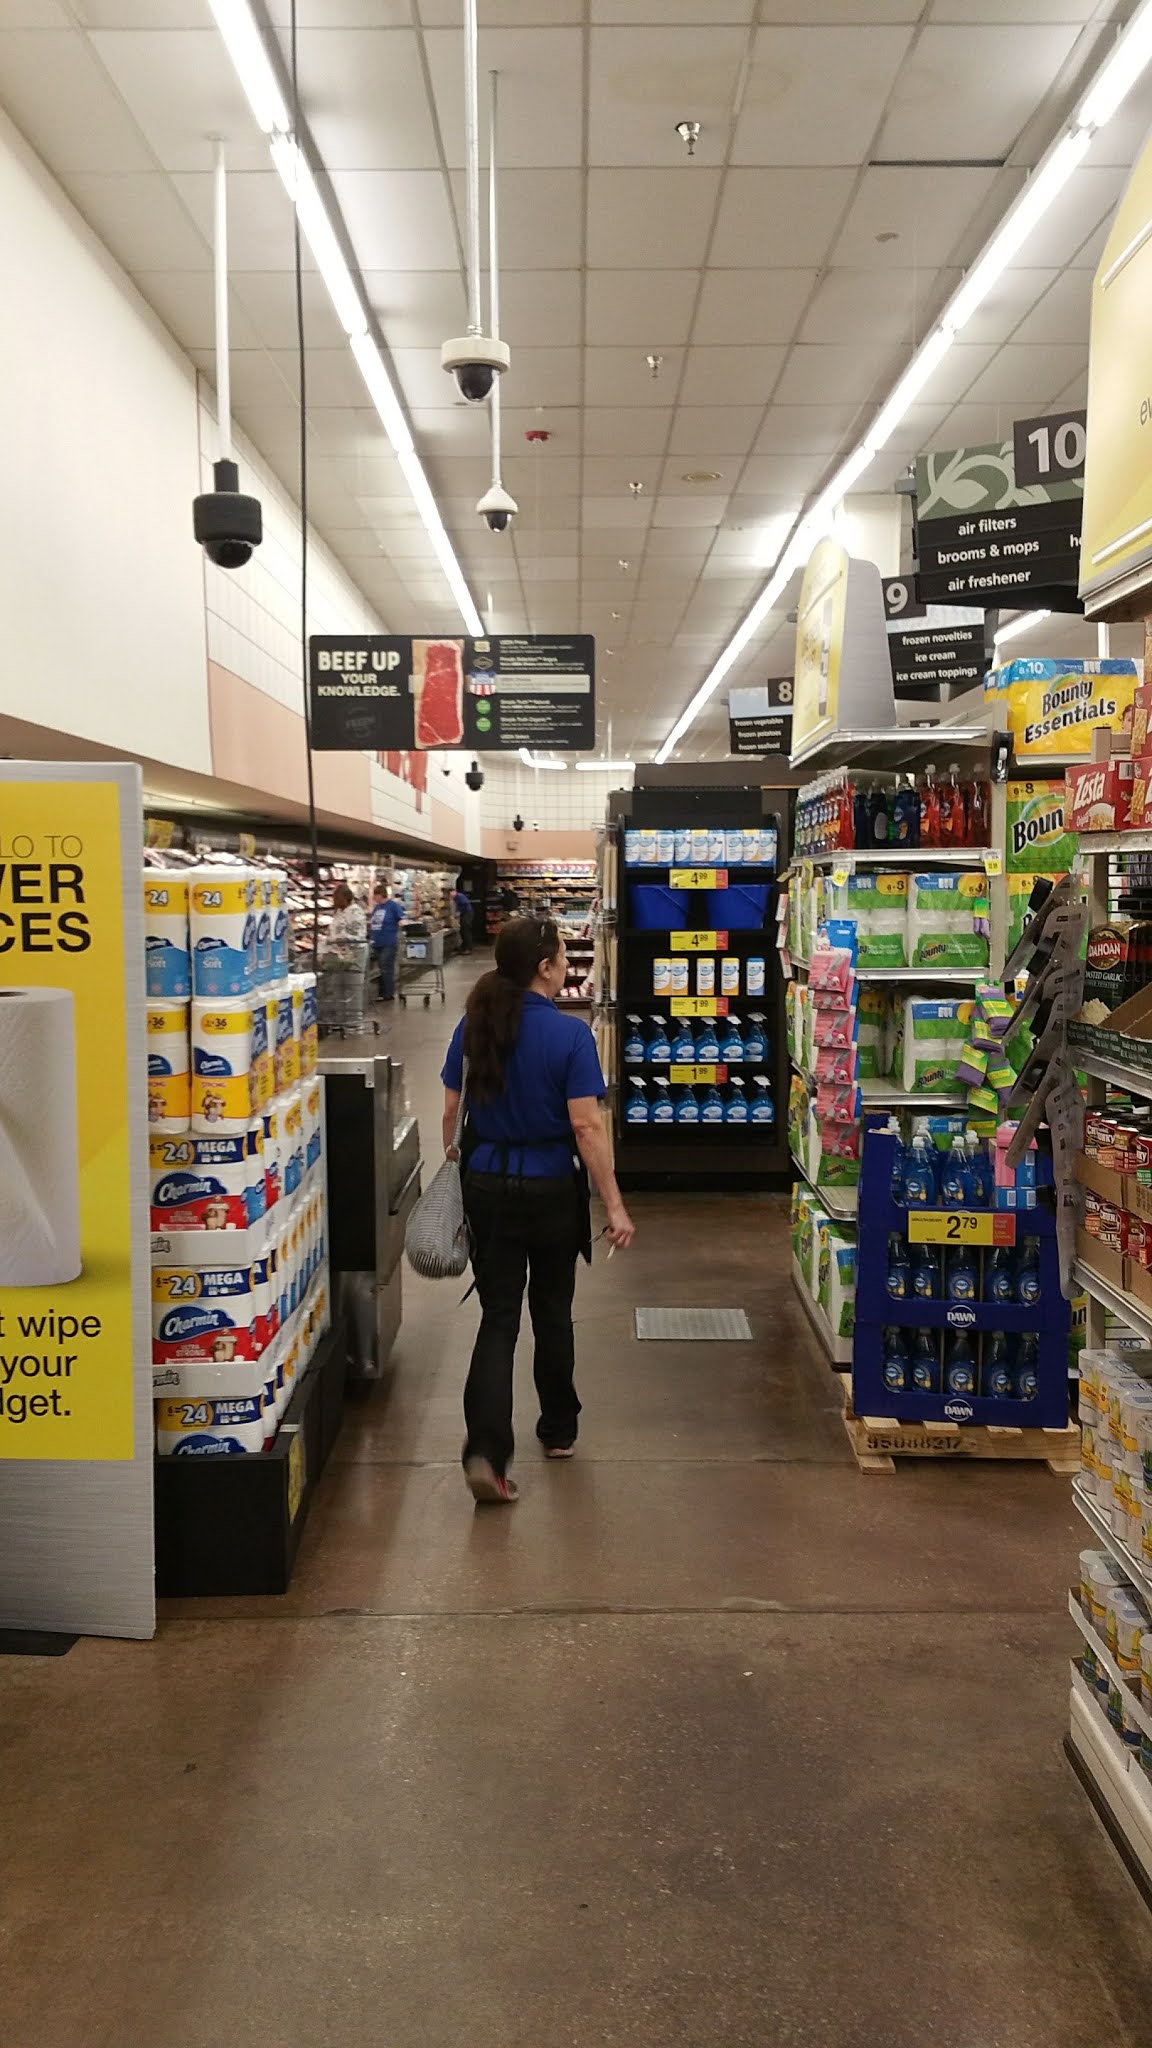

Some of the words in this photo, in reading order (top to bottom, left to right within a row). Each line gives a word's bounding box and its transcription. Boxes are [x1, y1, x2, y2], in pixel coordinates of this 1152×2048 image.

[1028, 421, 1086, 474] 10
[958, 522, 976, 536] air
[978, 517, 1017, 533] filters
[937, 547, 986, 565] brooms
[989, 544, 1000, 557] &
[1003, 540, 1040, 556] mops
[948, 578, 966, 592] air
[968, 569, 1031, 588] freshener
[886, 582, 909, 614] 9
[902, 635, 931, 646] frozen
[932, 631, 973, 643] novelties
[318, 651, 369, 671] BEEF
[371, 651, 401, 671] UP
[915, 653, 928, 663] ice
[928, 651, 956, 661] cream
[896, 672, 909, 681] ice
[910, 670, 936, 680] cream
[938, 666, 978, 679] toppings
[1027, 662, 1044, 674] 10
[340, 673, 378, 684] YOUR
[317, 685, 401, 697] KNOWLEDGE.
[778, 681, 793, 703] 8
[1042, 681, 1093, 717] Bounty
[1024, 698, 1116, 744] Essentials
[1025, 782, 1034, 794] 8
[1073, 772, 1106, 811] Zesta
[44, 835, 83, 858] TO
[149, 889, 169, 906] 24
[201, 891, 222, 907] 24
[202, 959, 222, 969] Soft
[215, 1018, 227, 1027] 36
[163, 1141, 190, 1163] 24
[197, 1140, 237, 1153] MEGA
[158, 1178, 212, 1202] Charmin
[169, 1275, 196, 1295] 24
[203, 1272, 245, 1286] MEGA
[164, 1310, 219, 1337] Charmin
[946, 1312, 976, 1322] DAWN
[17, 1309, 101, 1345] wipe
[0, 1355, 78, 1384] your
[181, 1404, 209, 1424] 24
[215, 1400, 255, 1414] MEGA
[944, 1405, 974, 1417] DAWN
